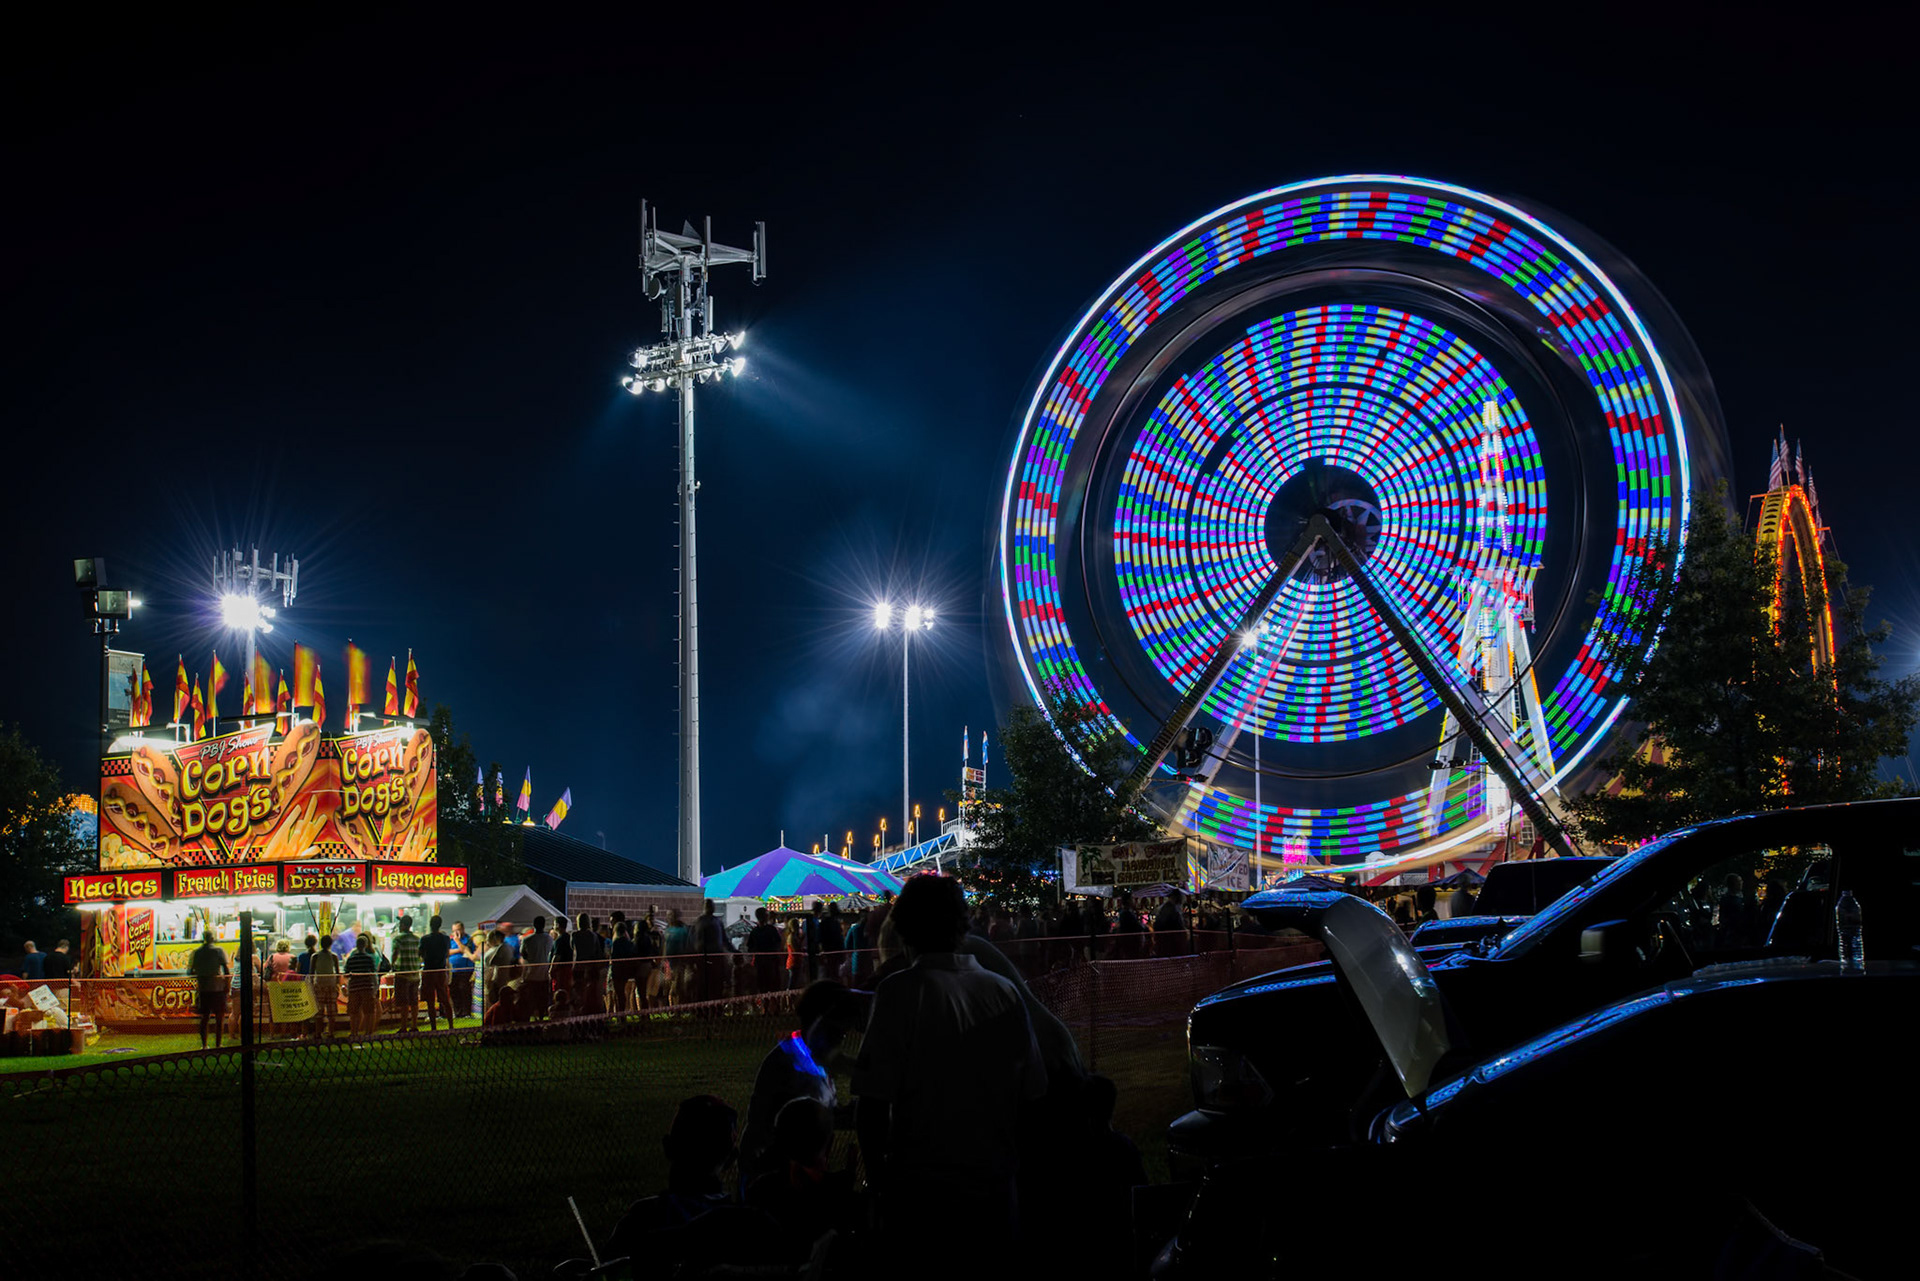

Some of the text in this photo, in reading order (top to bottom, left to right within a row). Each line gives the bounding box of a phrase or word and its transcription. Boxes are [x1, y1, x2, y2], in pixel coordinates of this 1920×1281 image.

[227, 736, 258, 755] Shows
[342, 741, 405, 782] Corn
[182, 746, 271, 799] Corn
[343, 776, 405, 818] Dogs
[181, 787, 272, 838] Dogs
[296, 865, 356, 874] Ice Cold
[375, 867, 465, 890] Lemonade
[1162, 867, 1181, 881] ICE
[69, 876, 158, 899] Nachos
[178, 868, 275, 894] French Fries
[289, 873, 362, 890] Drinks
[1226, 874, 1242, 889] ICE
[128, 920, 150, 939] Corn
[129, 935, 151, 955] Dogs
